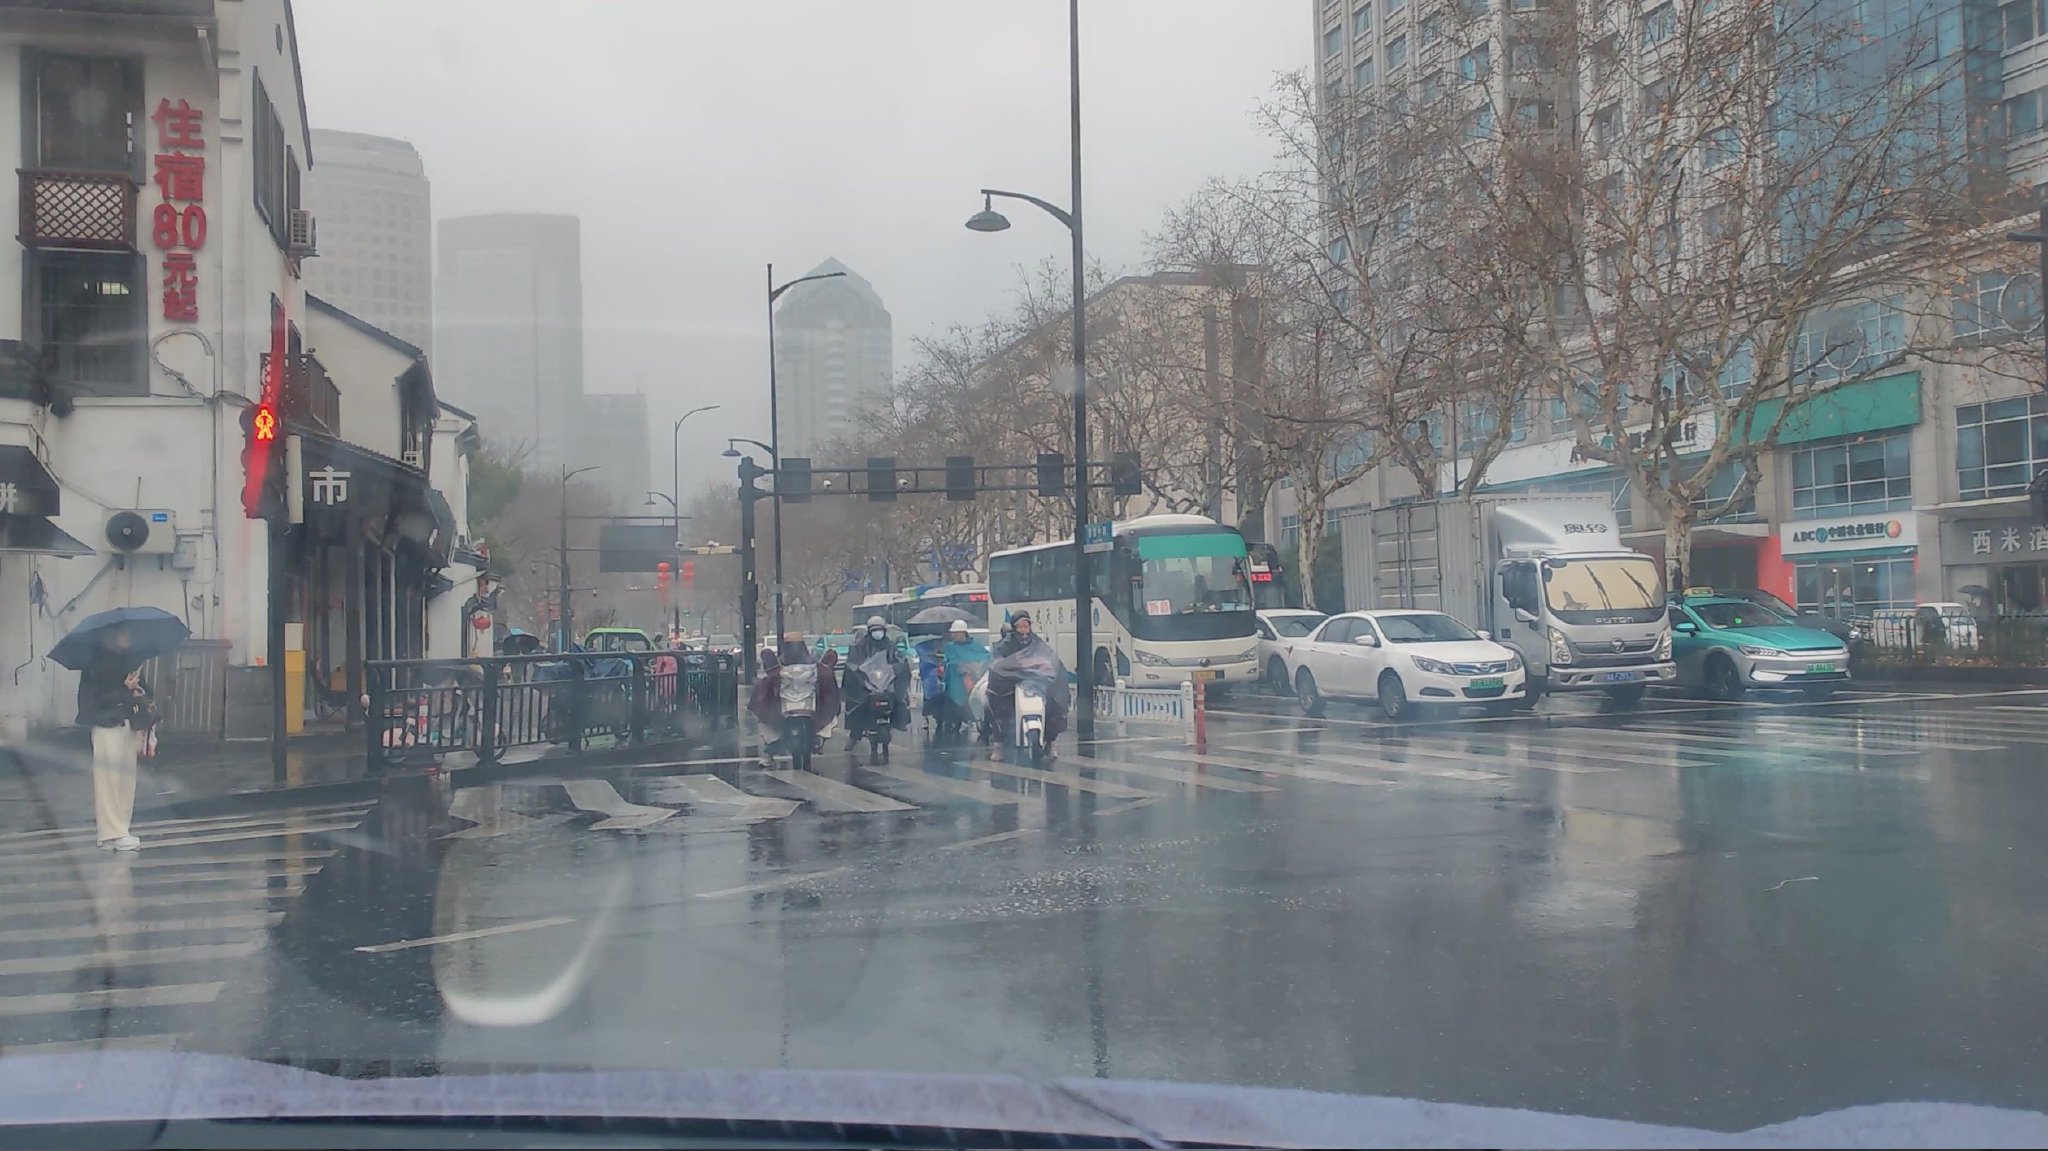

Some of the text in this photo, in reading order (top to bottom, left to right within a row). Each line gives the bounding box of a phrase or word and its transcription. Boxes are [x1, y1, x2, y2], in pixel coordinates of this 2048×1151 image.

[151, 98, 207, 321] 住宿80元起
[309, 465, 351, 505] 市
